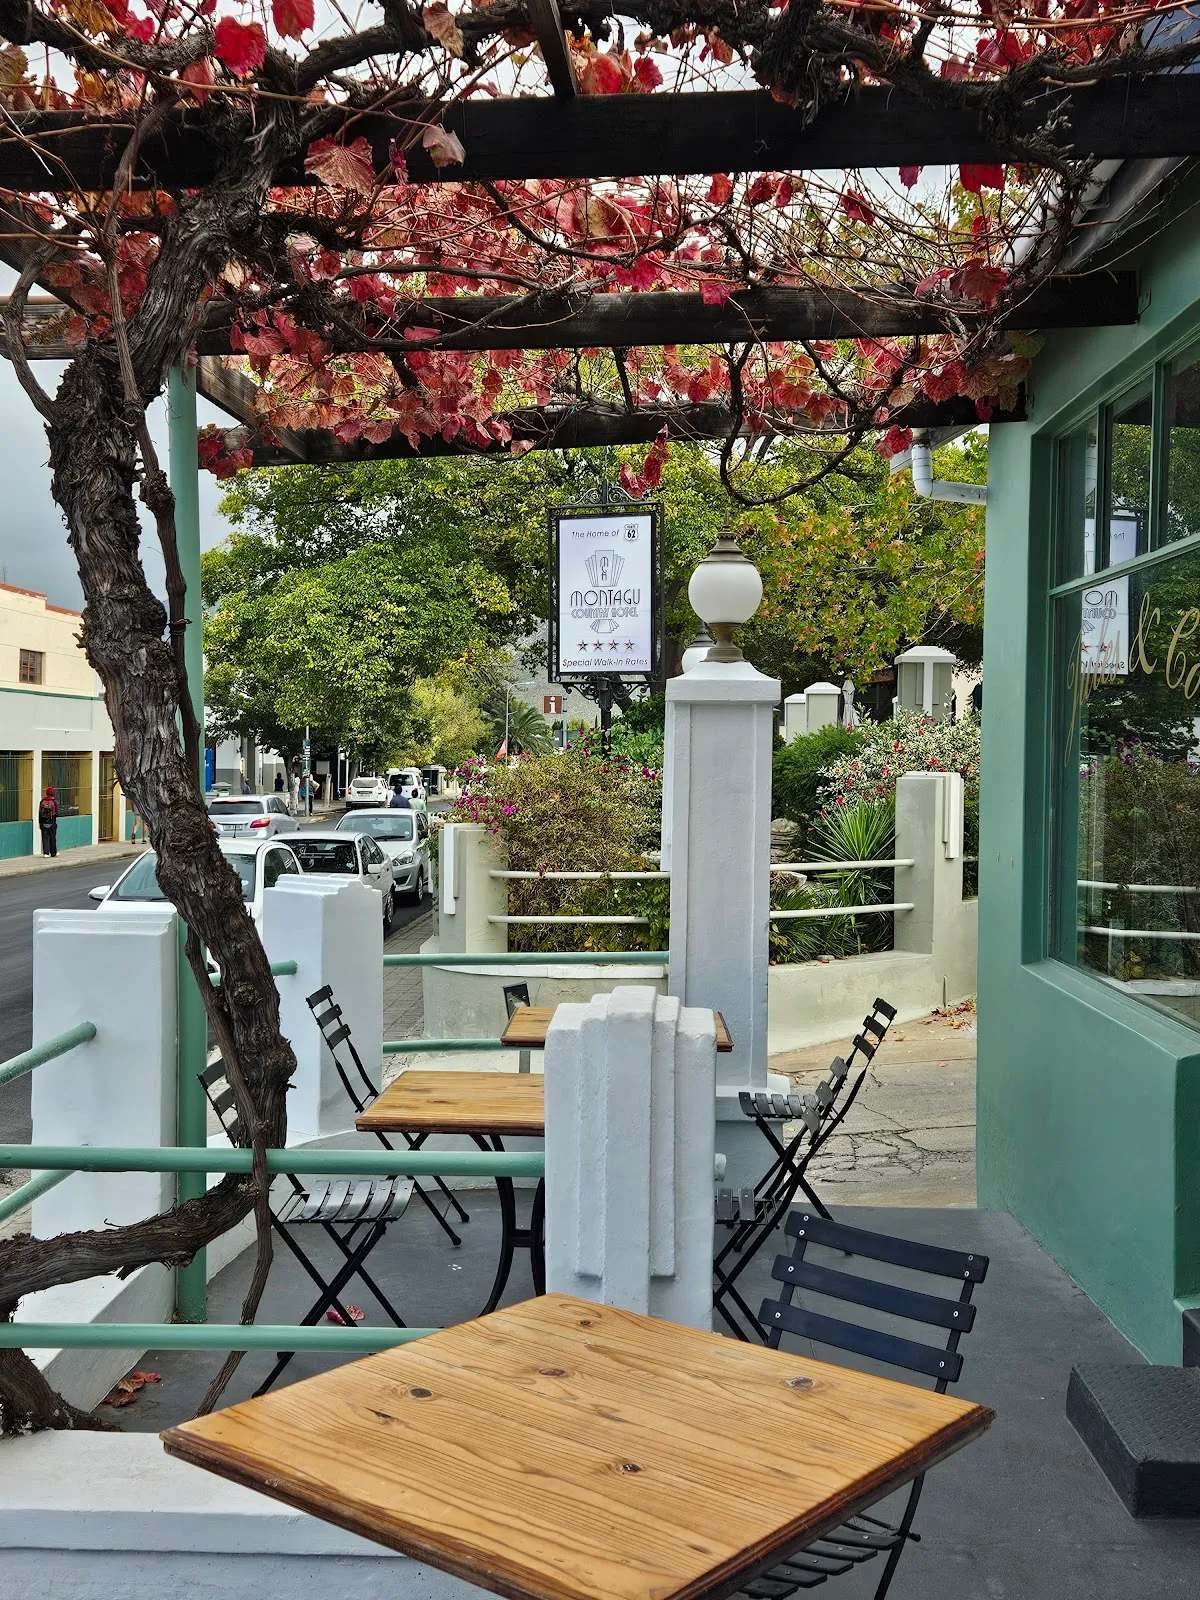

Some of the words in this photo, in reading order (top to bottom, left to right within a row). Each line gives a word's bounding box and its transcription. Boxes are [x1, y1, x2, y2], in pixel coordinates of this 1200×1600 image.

[627, 529, 636, 538] 62
[570, 588, 641, 606] MONTAGU
[570, 607, 609, 619] COUNTRY
[611, 606, 639, 617] HOTEL
[562, 658, 592, 667] Special
[625, 657, 648, 665] Rates
